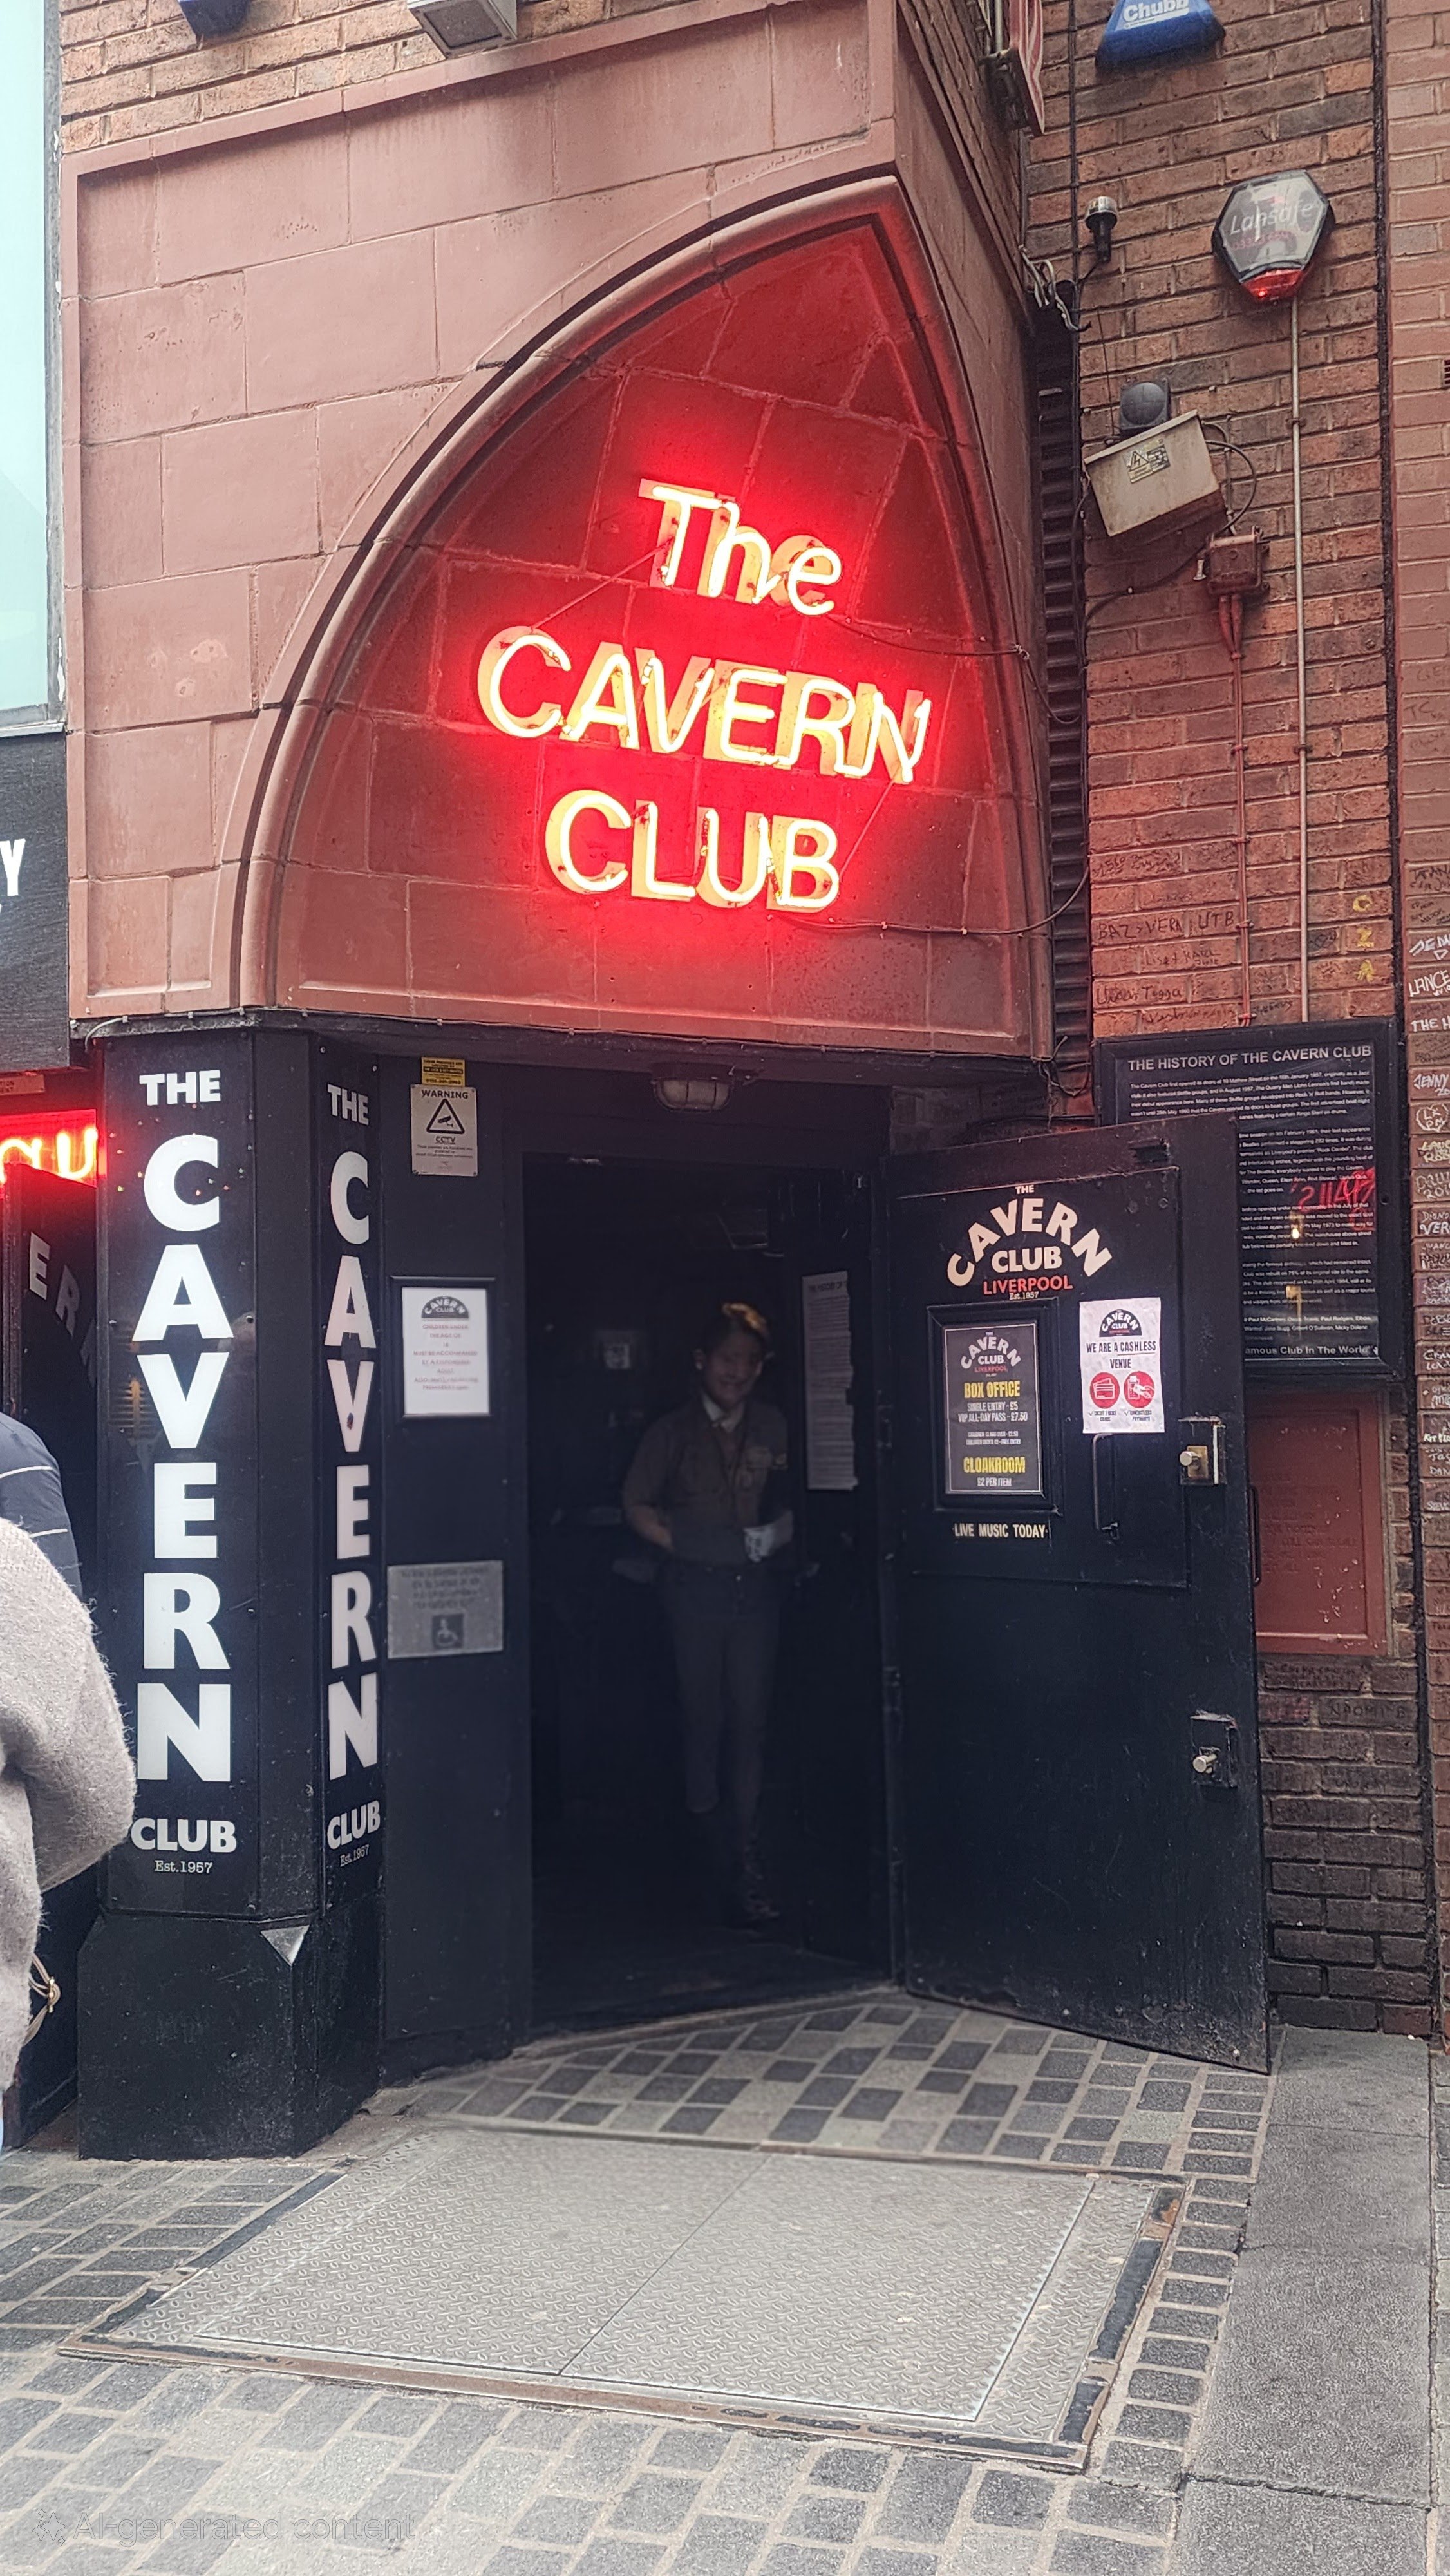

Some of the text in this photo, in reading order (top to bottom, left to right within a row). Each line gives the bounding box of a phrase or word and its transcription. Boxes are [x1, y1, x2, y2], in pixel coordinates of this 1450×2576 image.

[639, 479, 841, 616] The
[477, 625, 932, 783] CAVERN
[545, 790, 840, 912] CLUB
[1411, 1018, 1439, 1032] THE
[1128, 1045, 1371, 1071] THE HISTORY OF THE CAVERN CLUB
[139, 1070, 221, 1106] THE
[1413, 1074, 1449, 1090] JENNY
[421, 1089, 469, 1100] WARNING
[327, 1083, 370, 1126] THE
[1015, 1185, 1035, 1195] THE
[947, 1198, 1113, 1287] CAVERN
[992, 1246, 1062, 1273] CLUB
[983, 1275, 1074, 1295] LIVERPOOL
[425, 1299, 465, 1314] CAVERN
[1102, 1312, 1138, 1332] CAVERN
[961, 1336, 1021, 1369] CAVERN
[1087, 1341, 1156, 1353] WE ARE A CASHLESS
[1280, 1346, 1303, 1355] Club
[1317, 1346, 1336, 1354] The
[977, 1354, 1004, 1365] CLUB
[1110, 1358, 1132, 1369] VENUE
[964, 1381, 1021, 1398] BOX OFFICE
[967, 1402, 987, 1412] SINGLE
[1010, 1401, 1019, 1411] £5
[958, 1413, 968, 1423] VIP
[992, 1412, 1006, 1422] PASS
[1010, 1412, 1028, 1421] £7.50
[132, 1135, 234, 1782] CAVERN
[325, 1151, 377, 1780] CAVERN
[963, 1457, 1026, 1473] CLOAKROOM
[986, 1478, 997, 1487] PER
[998, 1477, 1012, 1486] ITEM
[954, 1523, 1046, 1538] LIVE MUSIC TODAY
[327, 1800, 381, 1850] CLUB
[131, 1817, 237, 1853] CLUB
[155, 1860, 213, 1874] Est.1957
